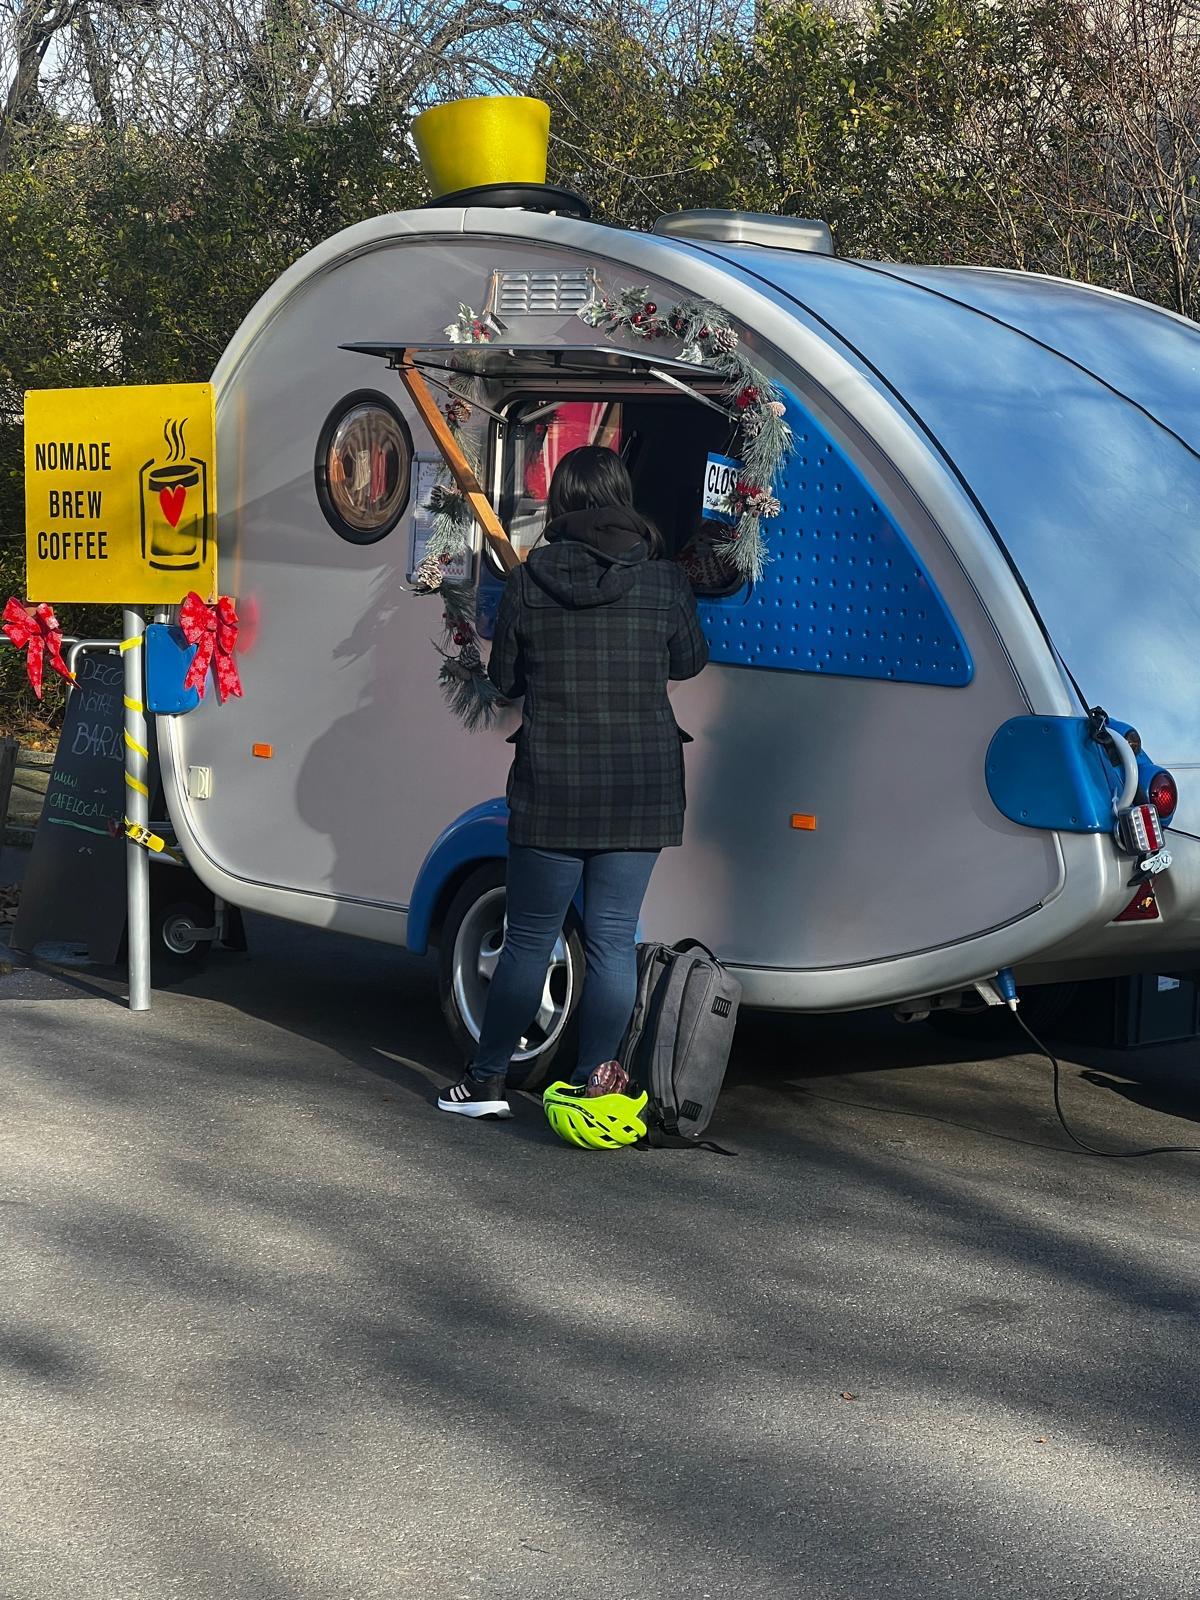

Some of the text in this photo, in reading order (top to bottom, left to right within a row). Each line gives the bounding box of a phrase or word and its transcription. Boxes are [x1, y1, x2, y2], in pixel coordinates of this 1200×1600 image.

[35, 441, 112, 471] NOMADE
[708, 464, 740, 495] CLOS
[49, 490, 102, 519] BREW
[37, 531, 108, 560] COFFEE
[82, 658, 124, 685] DECO
[71, 722, 124, 762] BARIS
